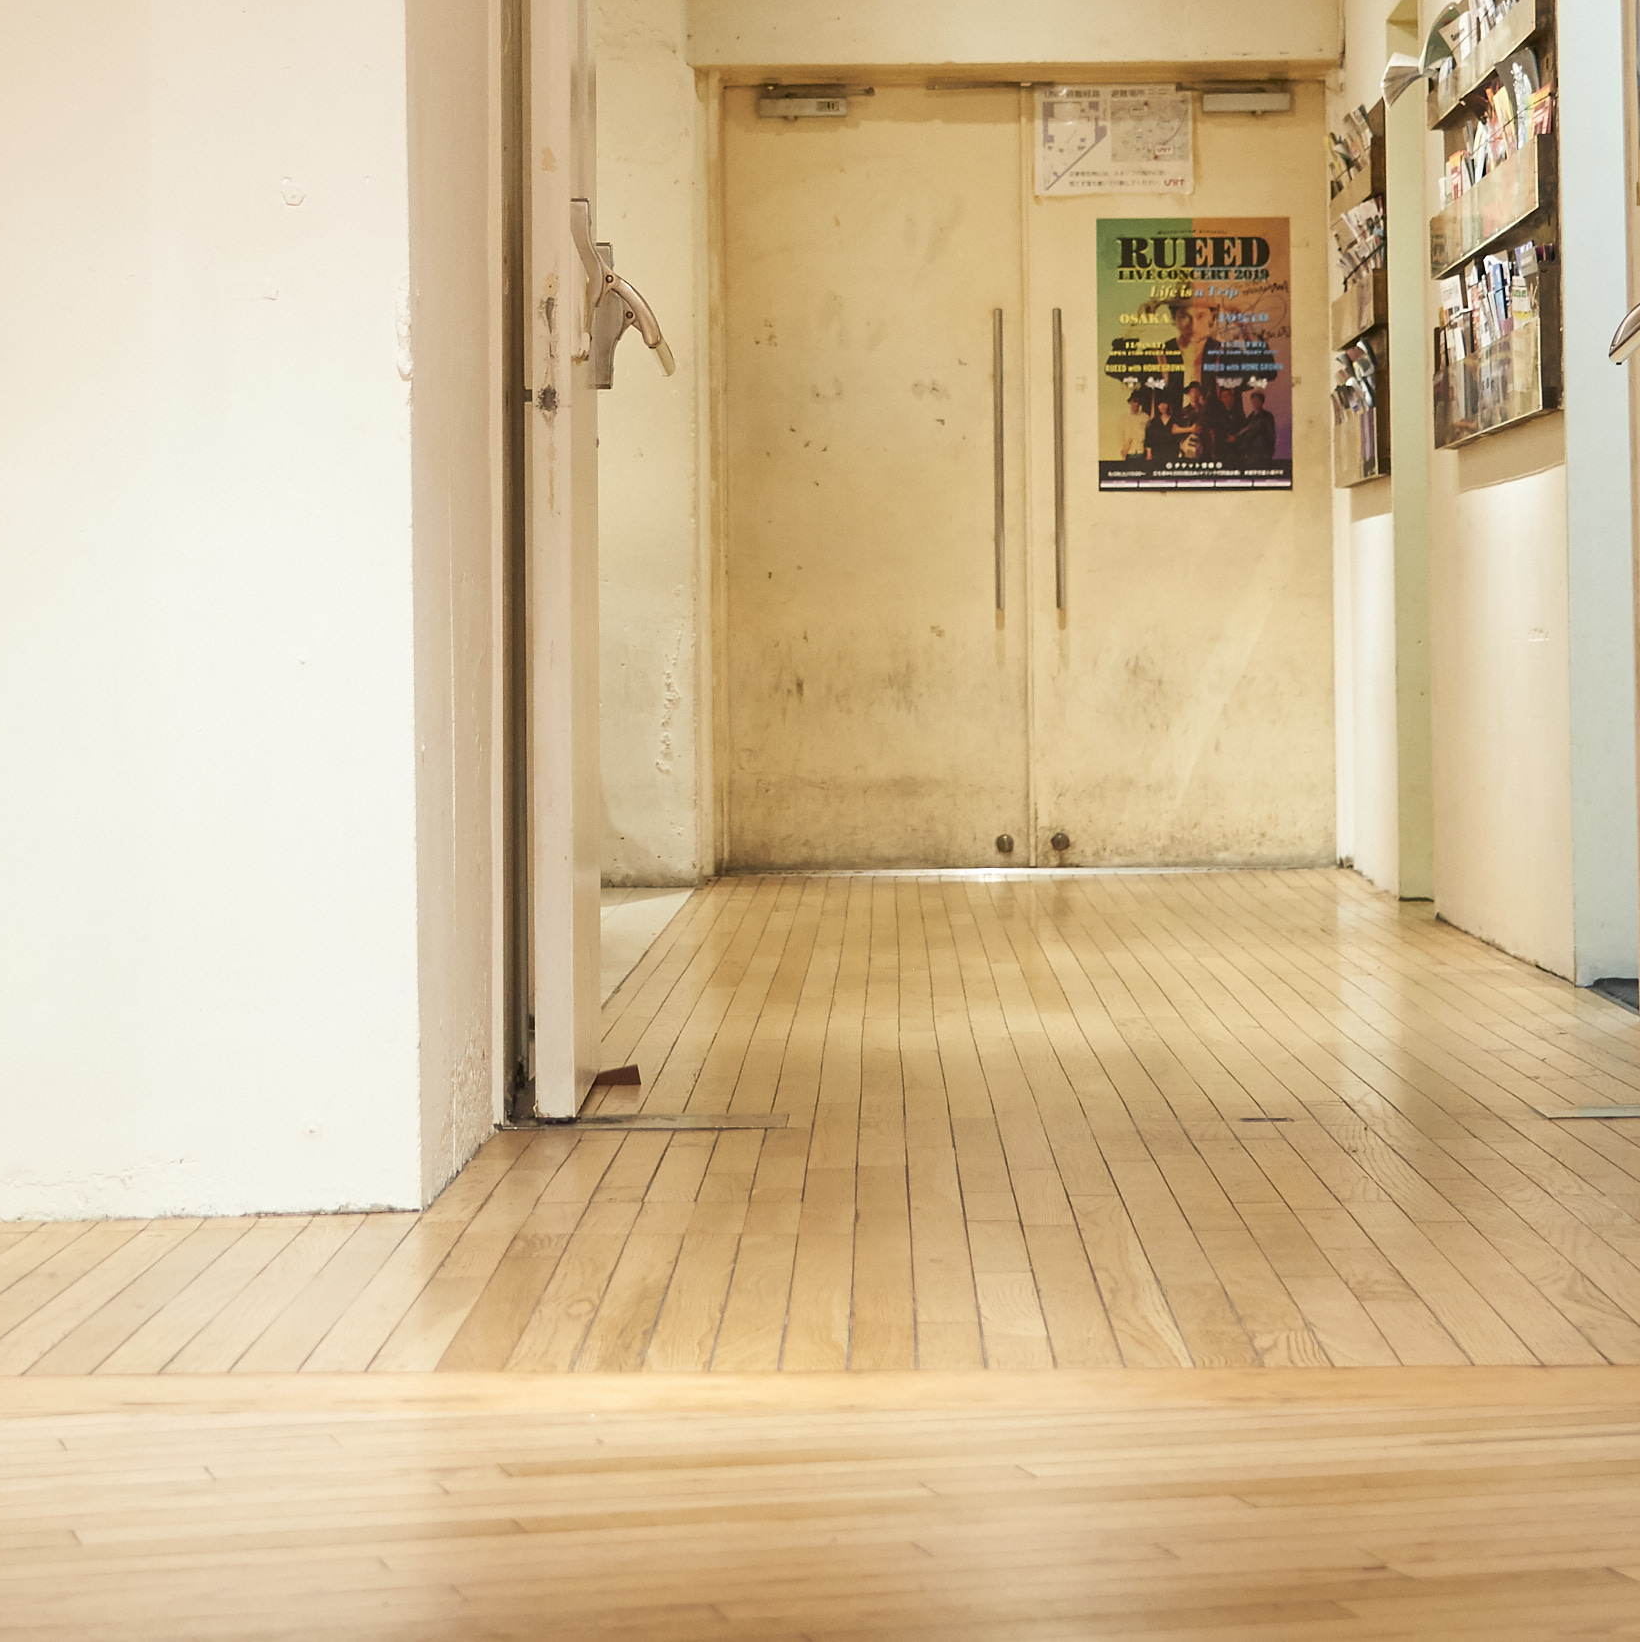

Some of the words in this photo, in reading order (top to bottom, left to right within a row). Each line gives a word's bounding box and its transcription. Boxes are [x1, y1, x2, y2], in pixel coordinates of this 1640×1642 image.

[1117, 236, 1270, 269] RUEED
[1118, 269, 1155, 281] LIVE
[1159, 269, 1232, 281] CONCERT
[1235, 268, 1270, 281] 2019
[1150, 285, 1178, 301] Life
[1180, 285, 1193, 298] is
[1195, 288, 1204, 298] a
[1208, 285, 1239, 300] Trip
[1119, 312, 1171, 325] OSAKA
